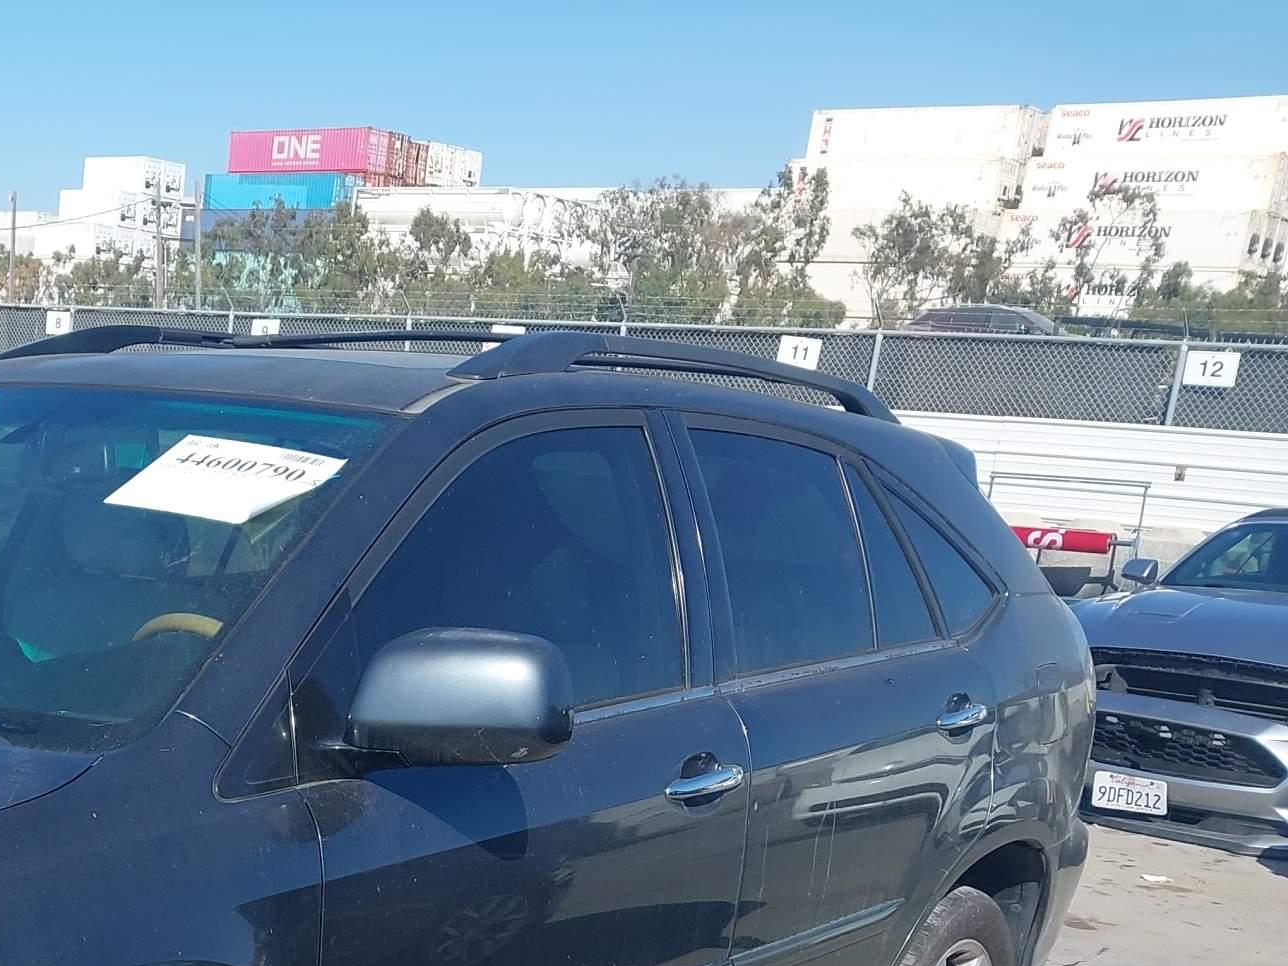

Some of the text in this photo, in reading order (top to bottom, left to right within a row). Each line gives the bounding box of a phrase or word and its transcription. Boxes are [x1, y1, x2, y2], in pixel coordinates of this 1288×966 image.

[1061, 109, 1090, 117] seaco
[1148, 114, 1228, 129] HORIZON
[1145, 128, 1212, 138] LINES
[272, 134, 322, 160] ONE
[1036, 161, 1065, 169] seaco
[1121, 170, 1200, 183] HORIZON
[1097, 225, 1172, 239] HORIZON
[55, 317, 61, 329] 8
[791, 345, 809, 361] 11
[1199, 359, 1224, 378] 12
[175, 452, 307, 482] 44600790
[1097, 785, 1162, 810] 9DFD212
